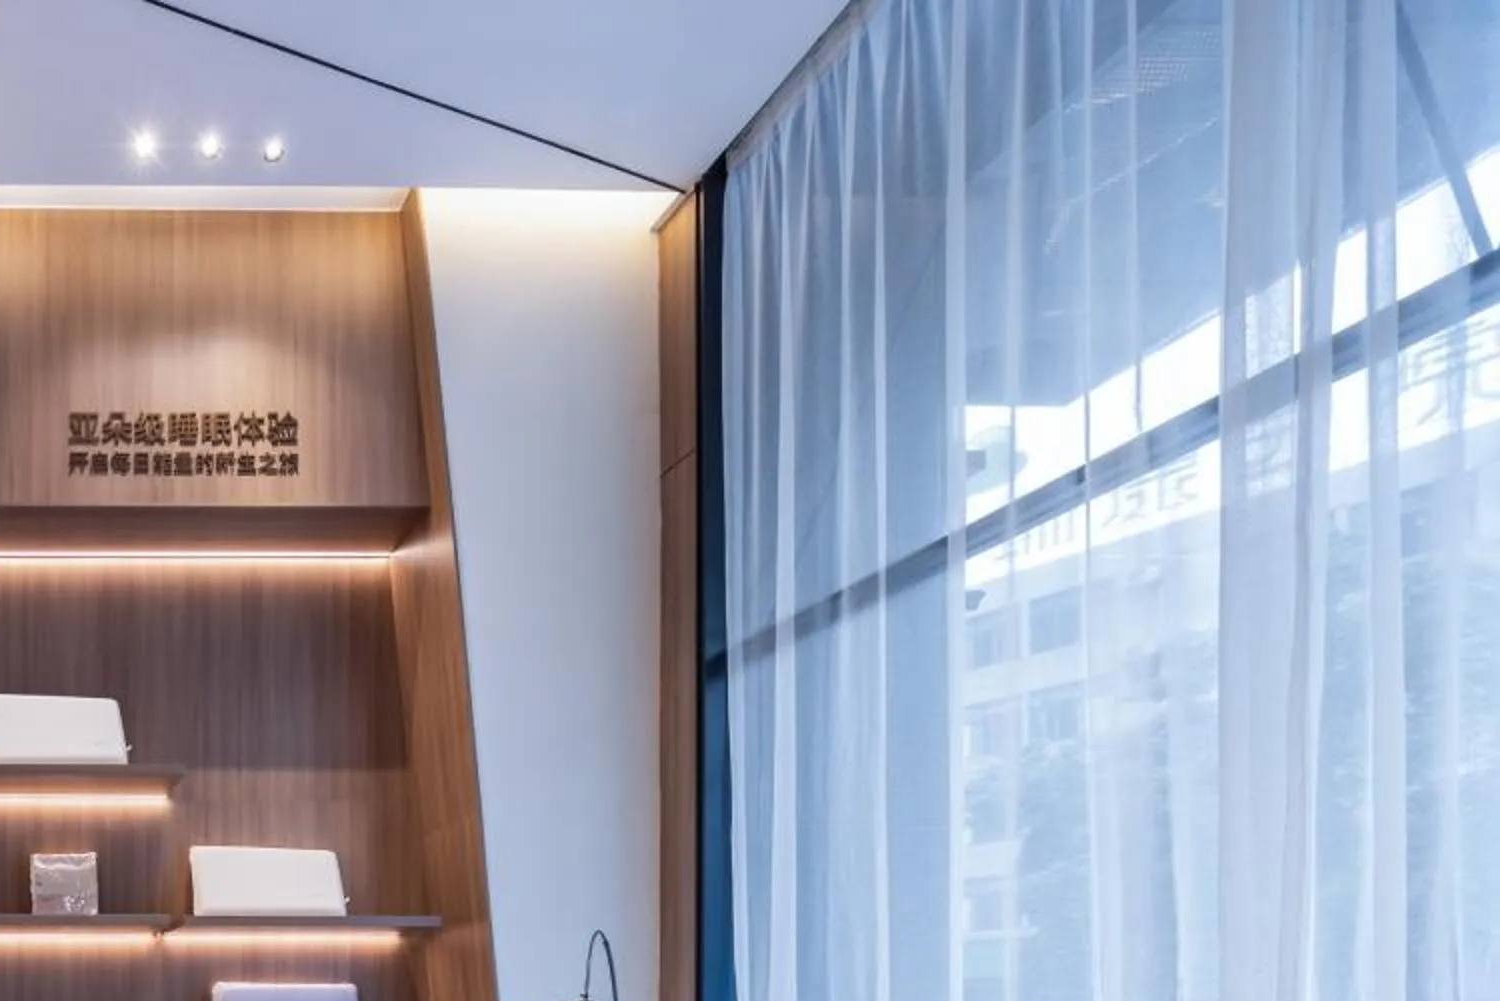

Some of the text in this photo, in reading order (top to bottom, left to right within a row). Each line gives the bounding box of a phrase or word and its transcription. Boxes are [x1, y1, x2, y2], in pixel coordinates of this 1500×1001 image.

[68, 411, 298, 447] 亚朵级睡眠体验
